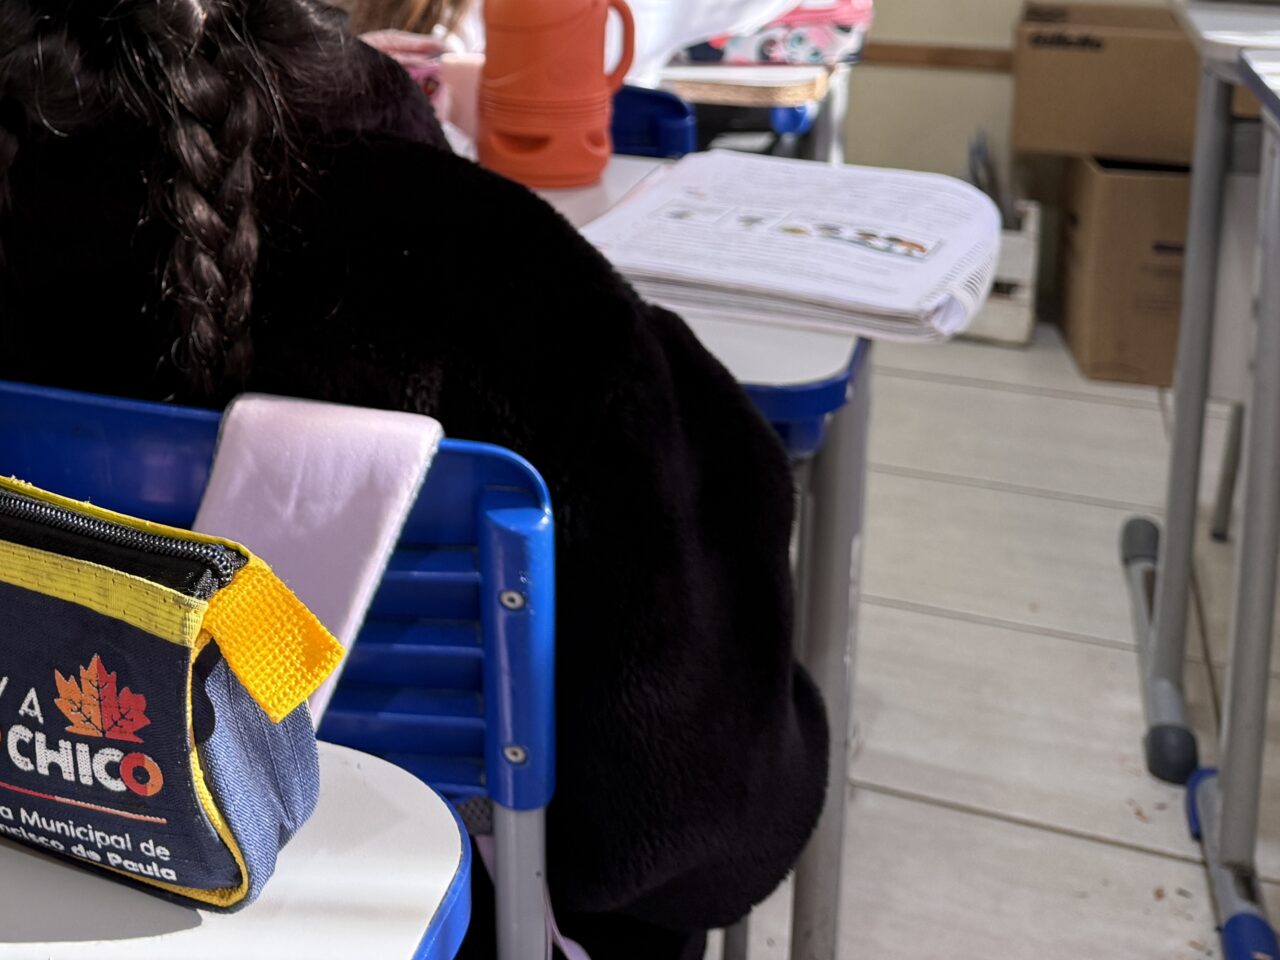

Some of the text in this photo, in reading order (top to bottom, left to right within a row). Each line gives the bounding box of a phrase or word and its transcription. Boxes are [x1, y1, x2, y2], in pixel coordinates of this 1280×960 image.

[7, 724, 164, 797] CHICO
[20, 807, 132, 852] Municipal
[140, 839, 171, 862] de
[71, 844, 102, 862] de
[107, 851, 178, 881] Paula
